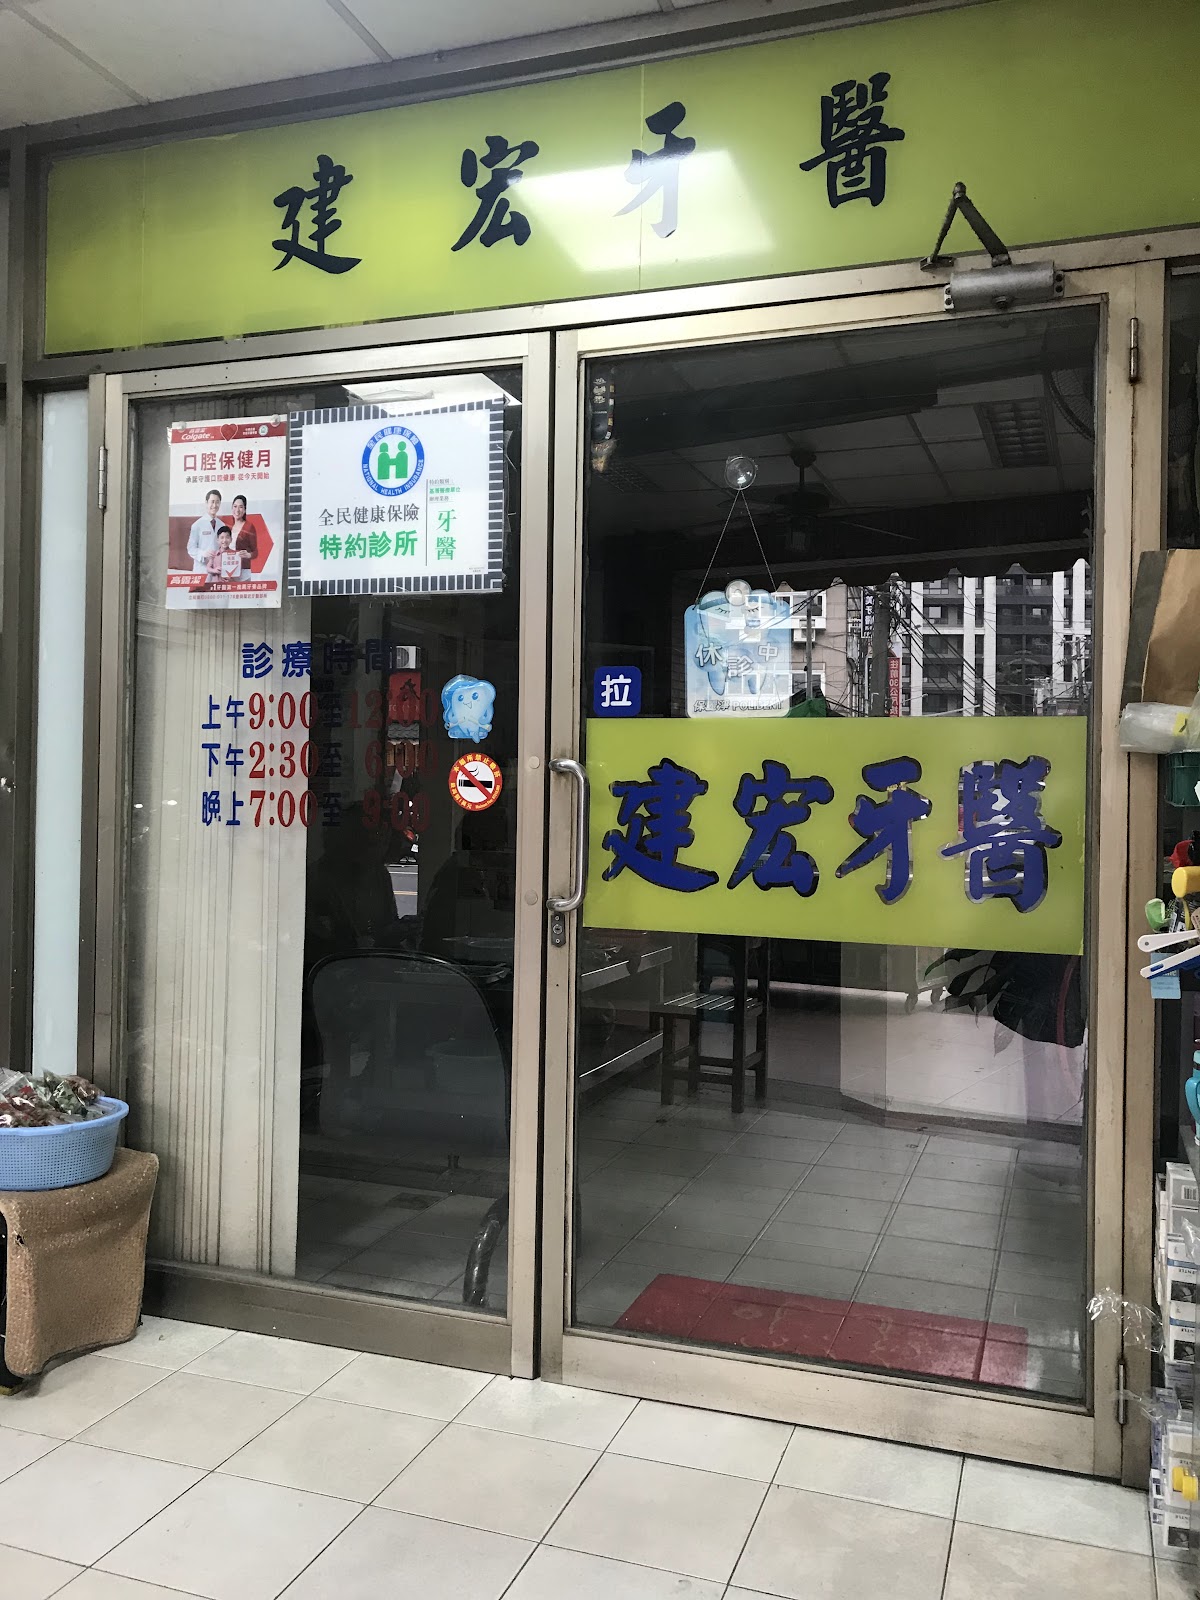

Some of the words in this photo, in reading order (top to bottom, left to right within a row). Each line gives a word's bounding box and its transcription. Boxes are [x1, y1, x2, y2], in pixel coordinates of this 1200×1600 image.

[272, 71, 905, 275] 建宏牙醫
[181, 432, 211, 441] Colgate
[367, 426, 420, 450] 全民健康保險
[183, 449, 271, 472] 口腔保健月
[362, 463, 379, 492] NATIONAL
[381, 487, 403, 496] HEALTH
[404, 458, 424, 492] INSURANCE
[318, 503, 421, 527] 全民健康保險
[319, 529, 418, 560] 特約診所
[435, 508, 457, 561] 牙醫
[170, 575, 202, 585] 高露潔
[241, 638, 395, 679] 診療時間
[600, 674, 632, 708] 拉
[601, 755, 1063, 913] 建宏牙醫
